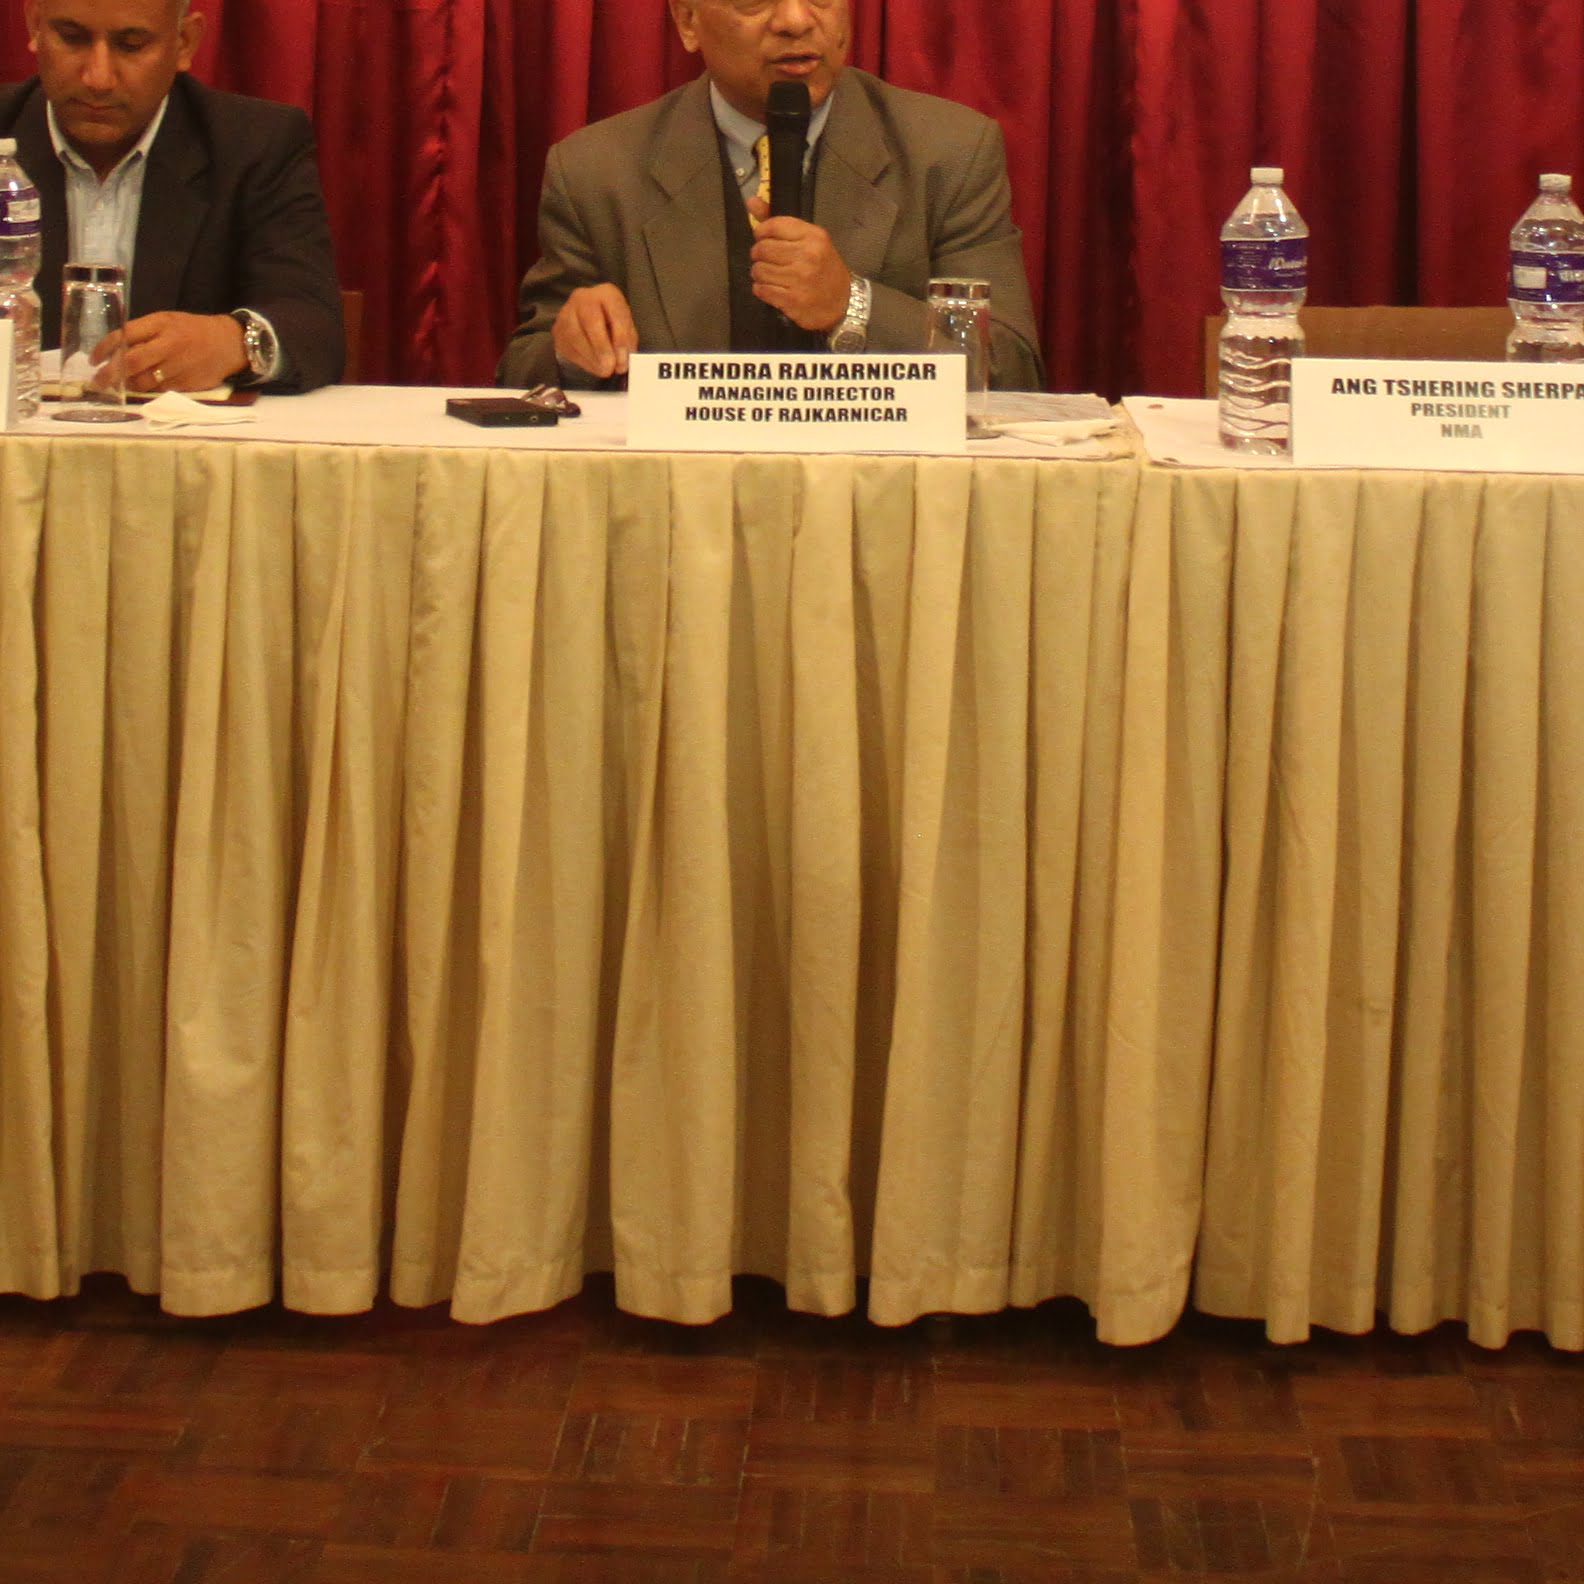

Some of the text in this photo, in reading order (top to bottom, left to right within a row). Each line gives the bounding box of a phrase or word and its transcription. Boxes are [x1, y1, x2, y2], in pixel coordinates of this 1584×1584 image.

[658, 363, 937, 381] BIRENDRA RAJKARNICAR
[698, 387, 895, 401] MANAGING DIRECTOR
[1331, 378, 1377, 395] ANG
[1383, 379, 1496, 398] TSHERING
[685, 406, 908, 422] HOUSE OF RAJKARNICAR
[1411, 402, 1510, 418] PRESIDENT
[1441, 424, 1482, 439] NMA
